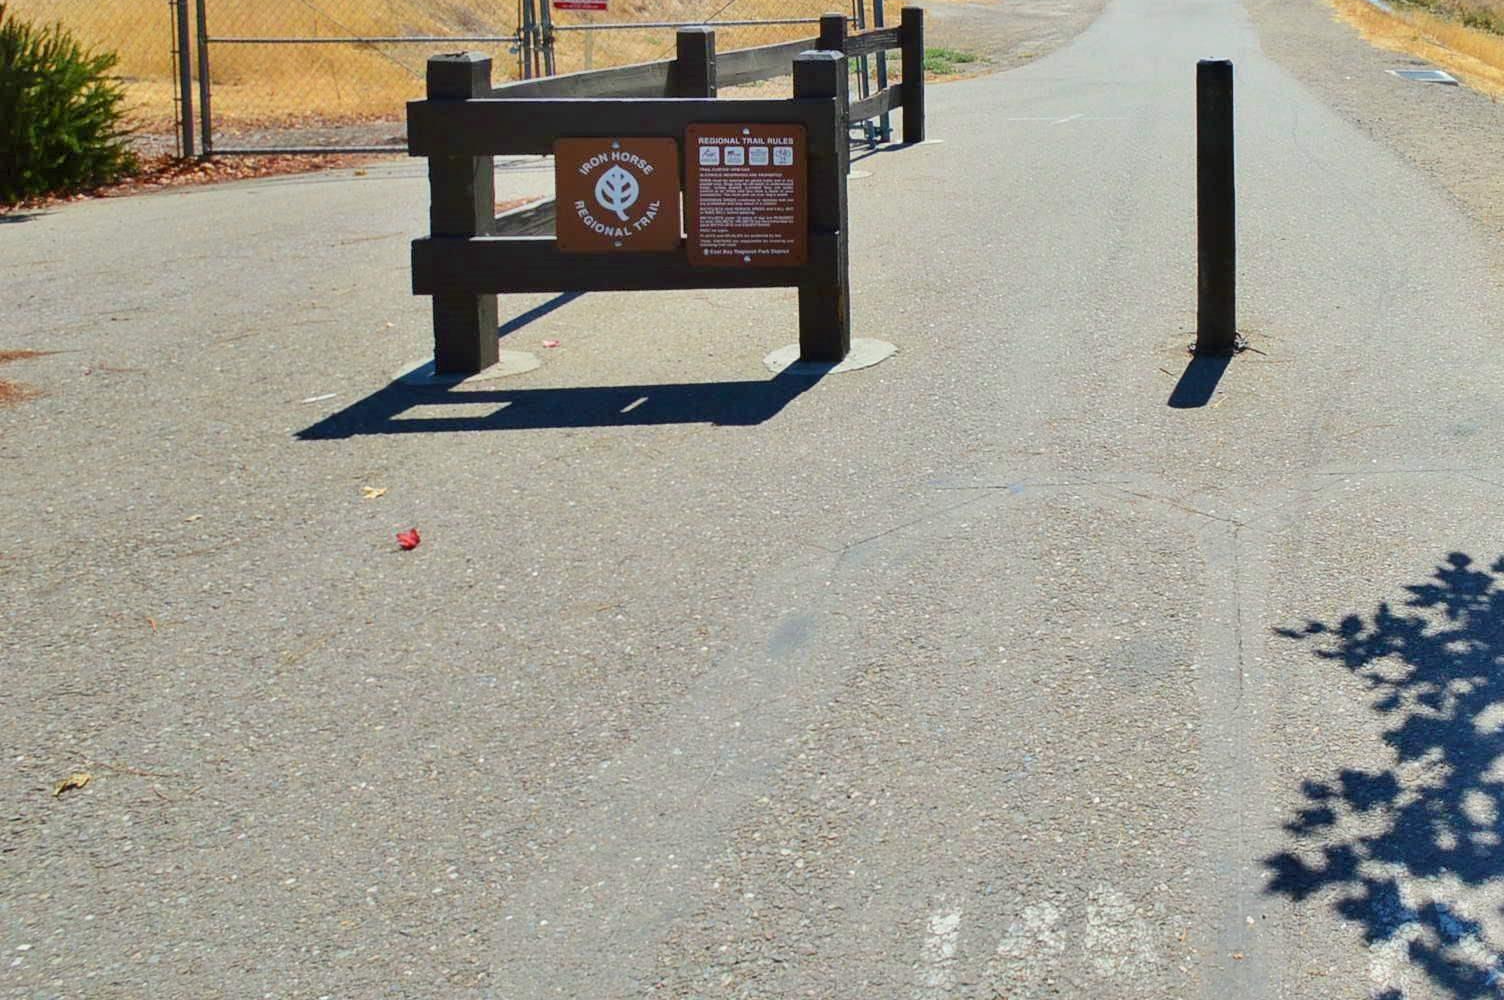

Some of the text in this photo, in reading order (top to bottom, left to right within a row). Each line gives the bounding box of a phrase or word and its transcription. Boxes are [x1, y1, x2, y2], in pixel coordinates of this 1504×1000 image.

[698, 137, 794, 145] REGIONAL TRAIL RULES
[580, 151, 654, 175] IRON HORSE
[574, 200, 661, 238] REGIONAL TRAIL
